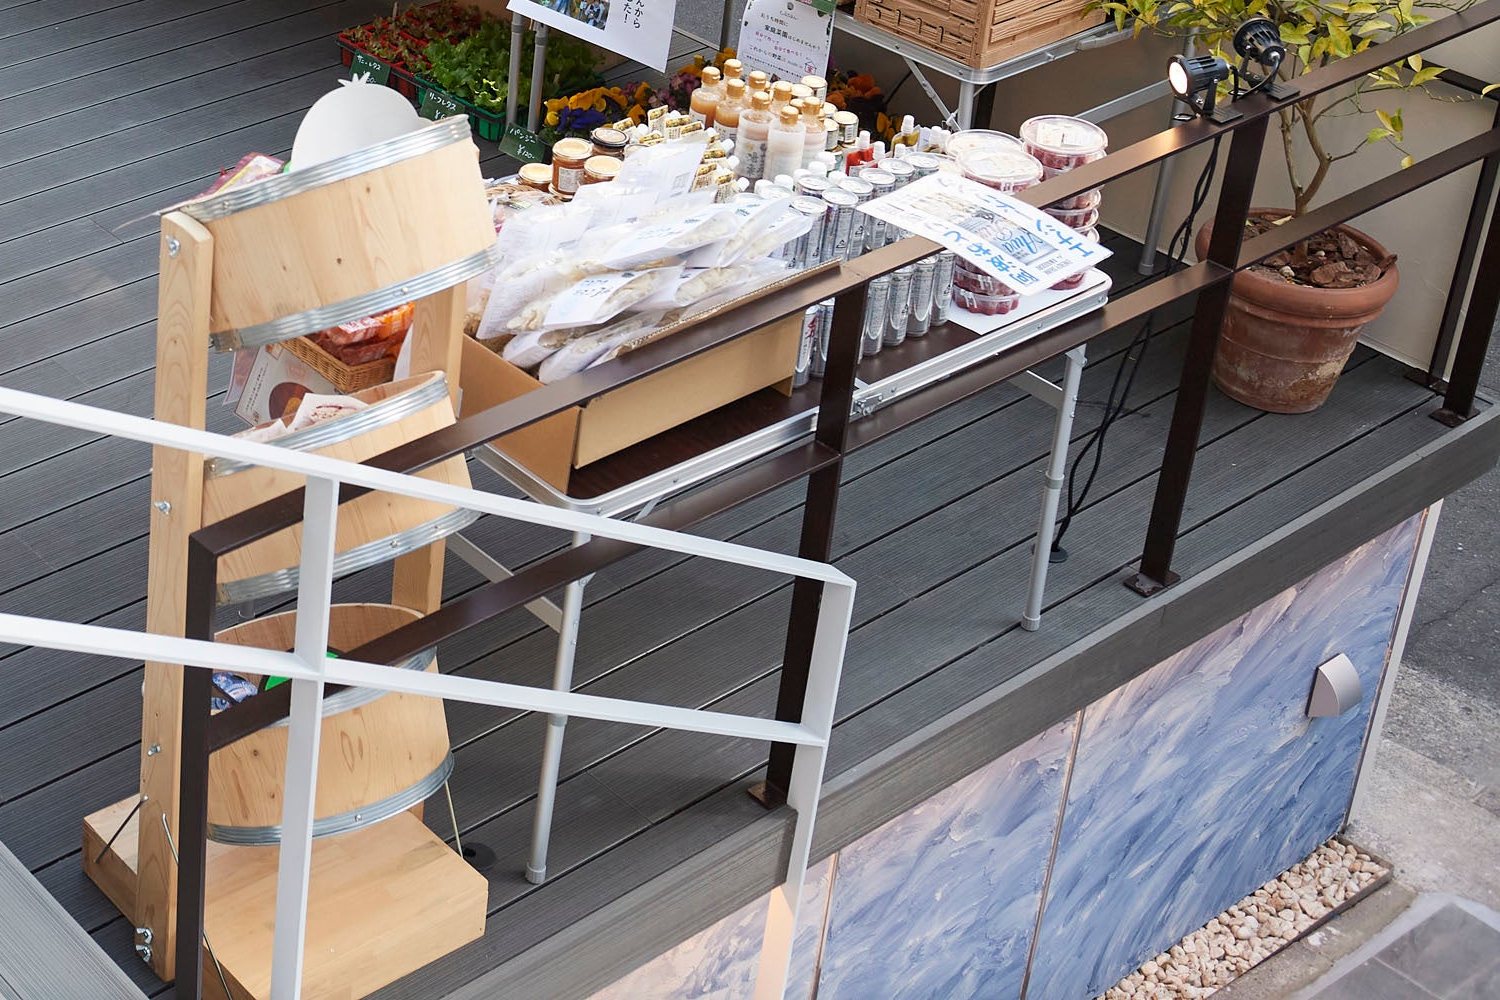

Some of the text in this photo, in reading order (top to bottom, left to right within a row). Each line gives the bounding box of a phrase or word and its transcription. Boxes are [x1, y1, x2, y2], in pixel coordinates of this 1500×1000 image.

[357, 54, 381, 71] サニーレタス
[429, 92, 456, 111] リーフレタス
[509, 128, 536, 144] パンジー
